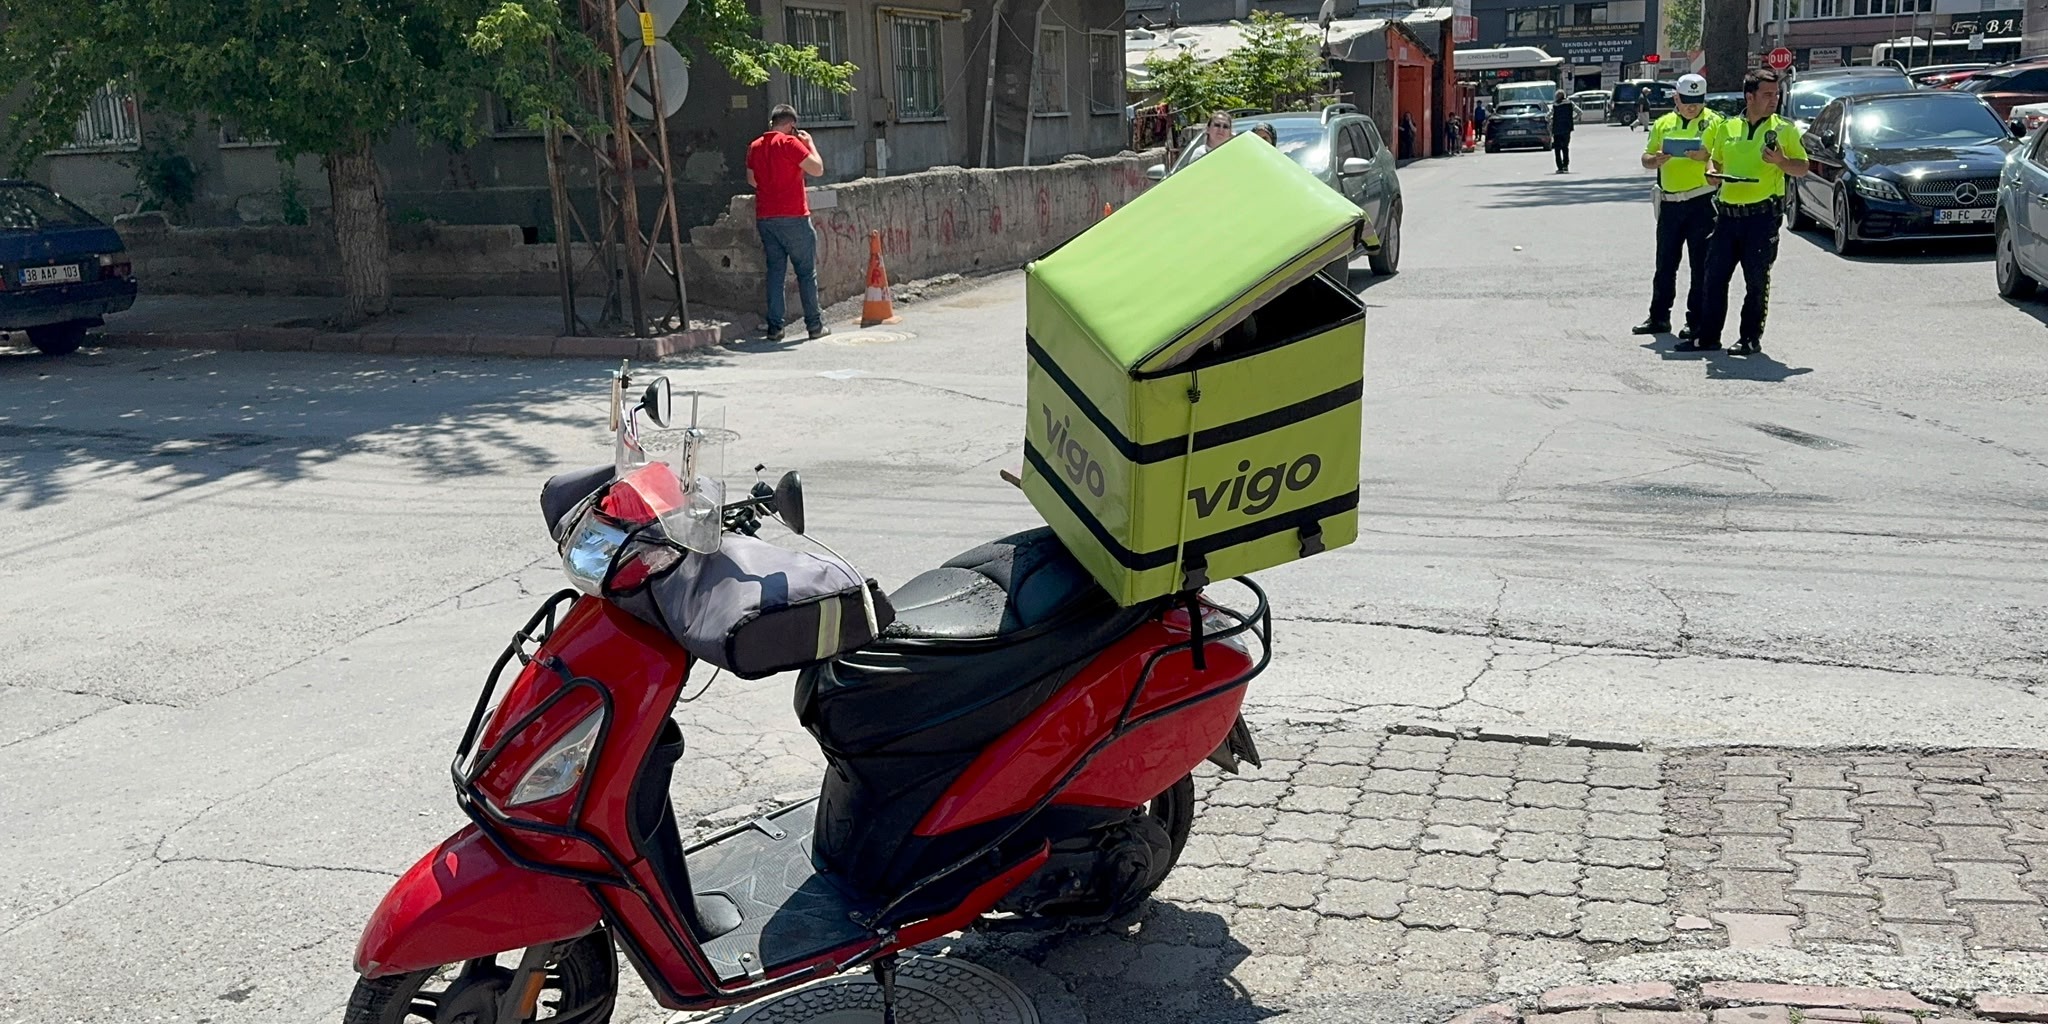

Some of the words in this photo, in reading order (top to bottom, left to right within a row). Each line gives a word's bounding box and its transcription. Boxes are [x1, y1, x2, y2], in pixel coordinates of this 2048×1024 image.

[1770, 53, 1790, 64] DUR
[1941, 210, 1952, 220] 38
[1958, 209, 1970, 220] FC
[25, 269, 38, 281] 38
[41, 267, 57, 280] AAP
[63, 265, 78, 278] 103
[1042, 402, 1105, 498] vigo
[1187, 453, 1322, 520] vigo
